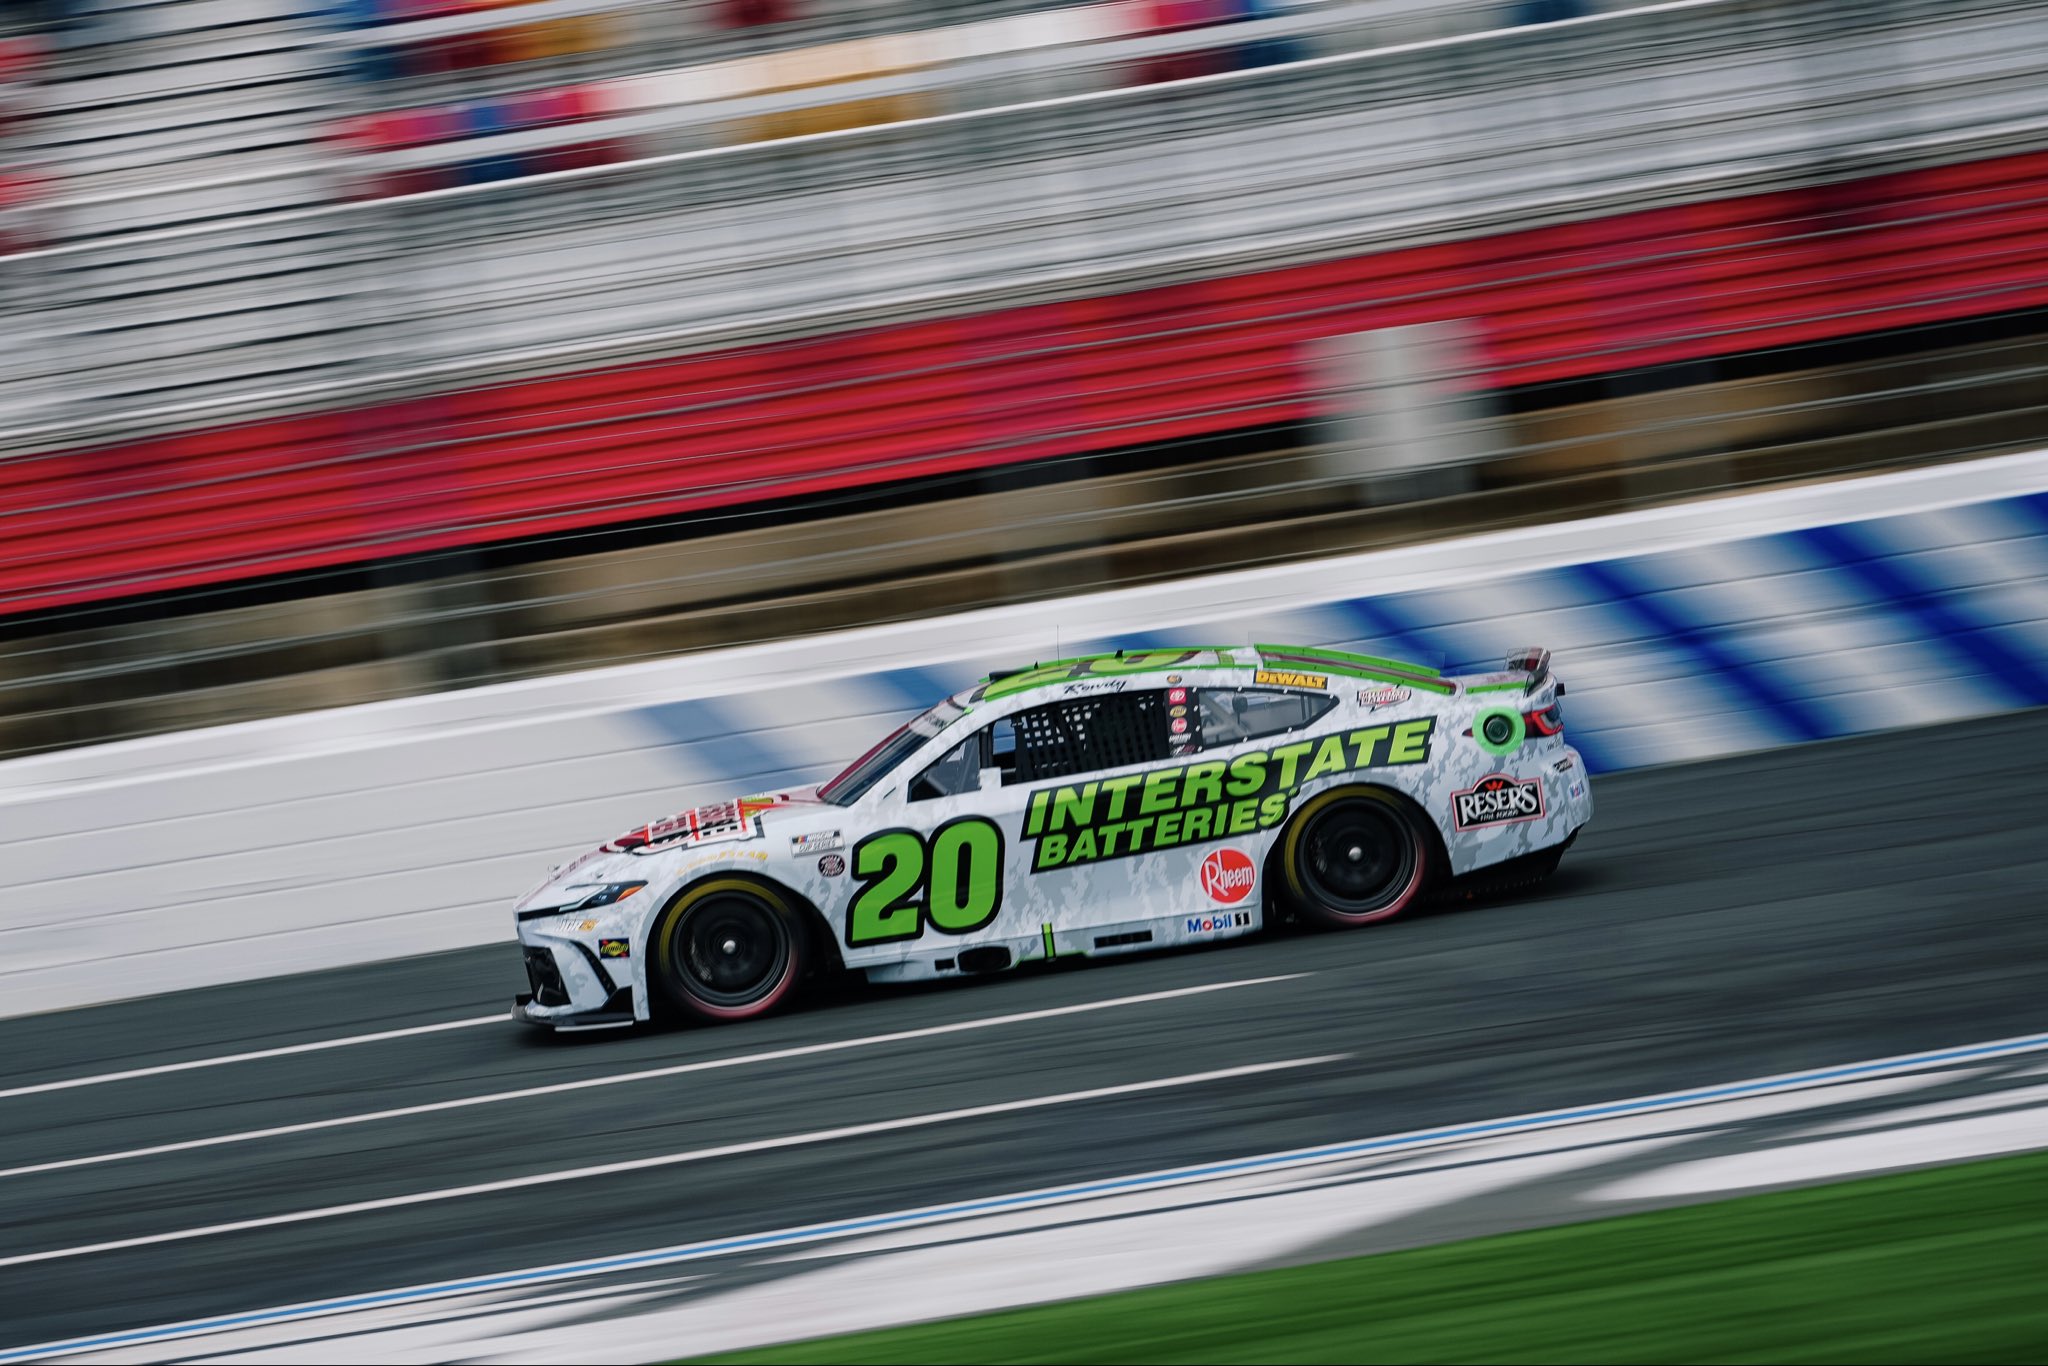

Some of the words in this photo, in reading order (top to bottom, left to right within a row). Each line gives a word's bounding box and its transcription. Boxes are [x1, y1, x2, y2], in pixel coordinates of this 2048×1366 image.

[1025, 718, 1433, 838] INTERSTATE
[1036, 796, 1289, 869] BATTERIES
[846, 815, 1005, 948] 20
[1204, 849, 1253, 897] Rheem
[1187, 914, 1232, 933] Mobil
[1235, 912, 1250, 927] 1
